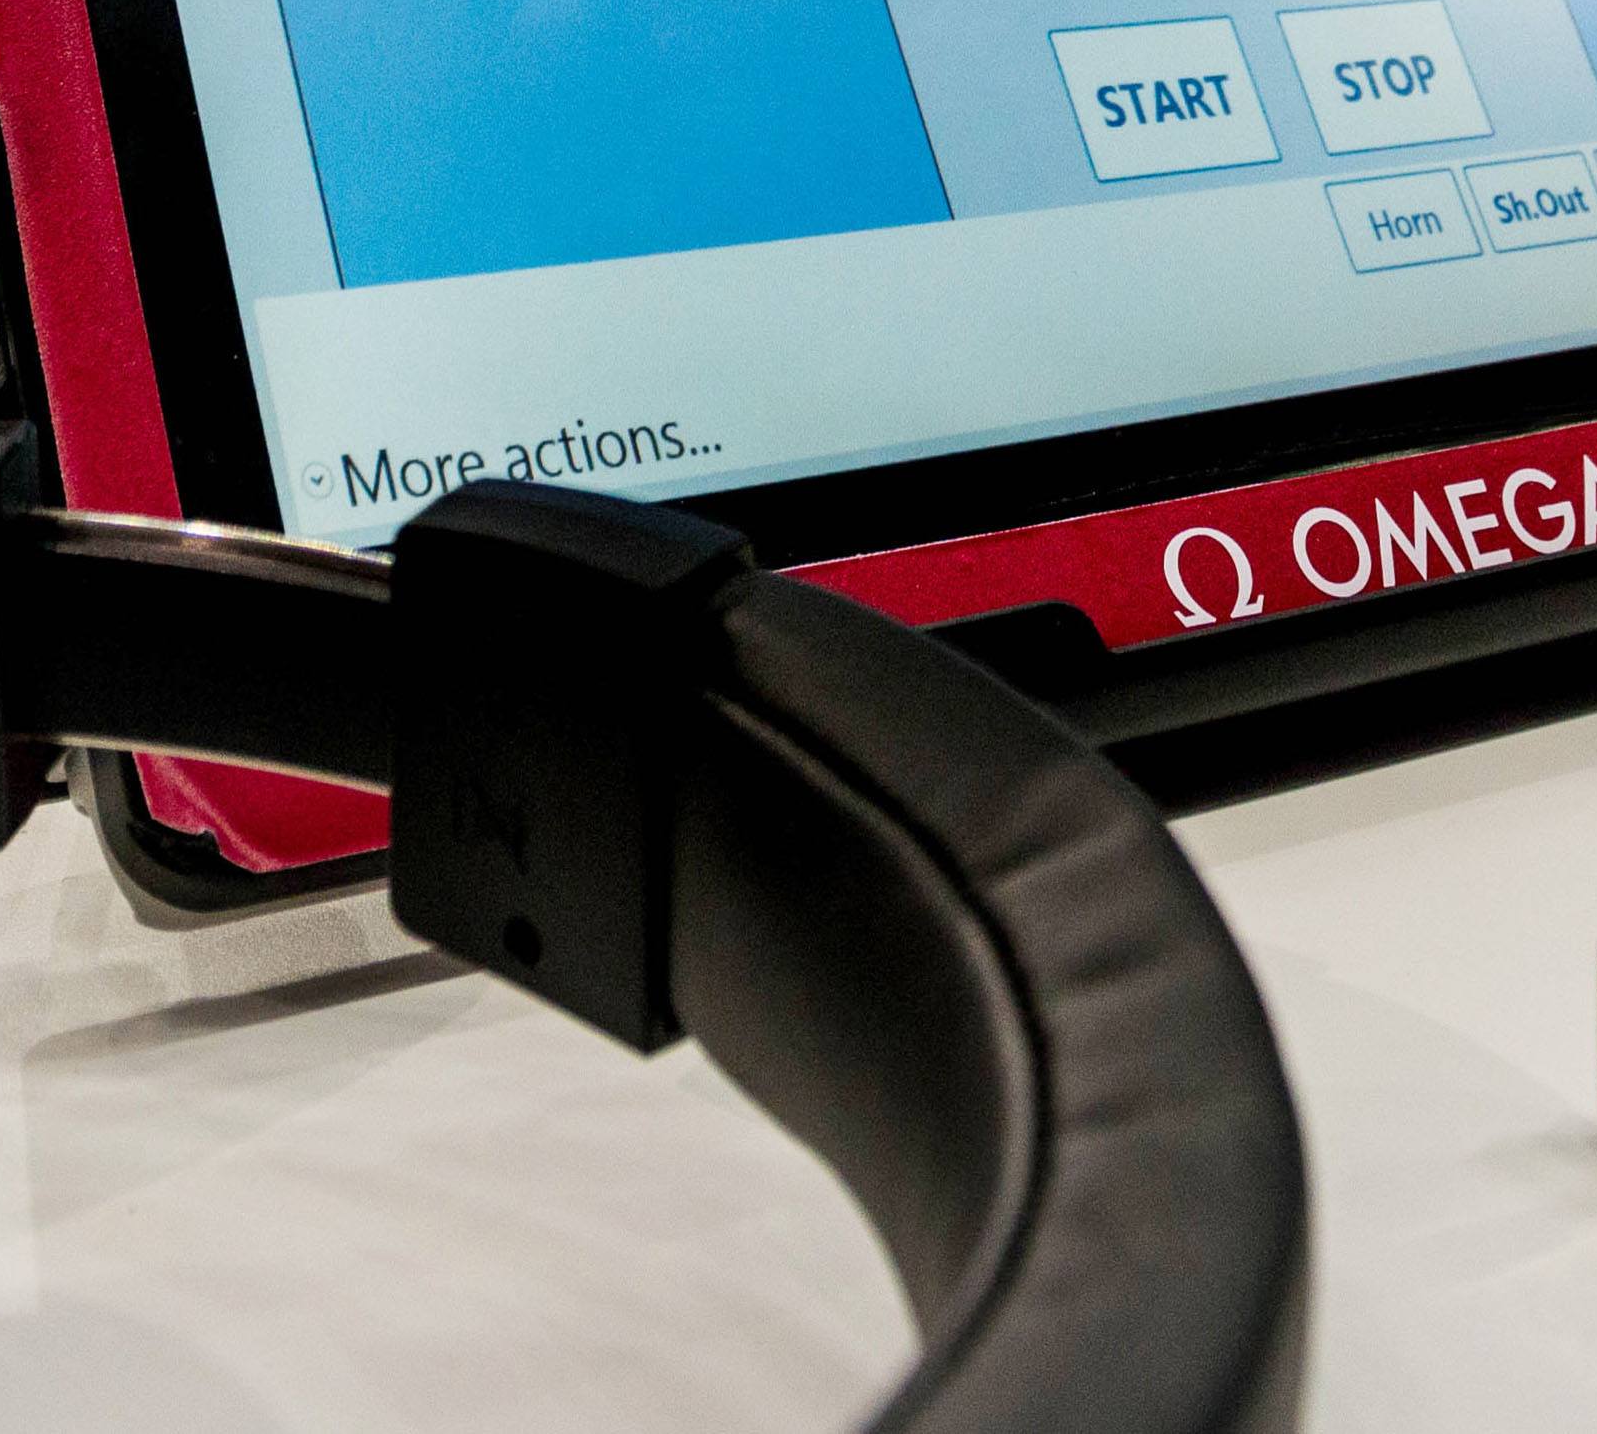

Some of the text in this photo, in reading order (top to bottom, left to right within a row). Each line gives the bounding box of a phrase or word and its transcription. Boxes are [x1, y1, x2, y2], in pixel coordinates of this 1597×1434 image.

[1095, 73, 1237, 129] START
[1333, 53, 1437, 103] STOP
[1367, 207, 1444, 243] Horn
[1493, 185, 1590, 225] Sh.Out
[340, 418, 723, 508] More actions...
